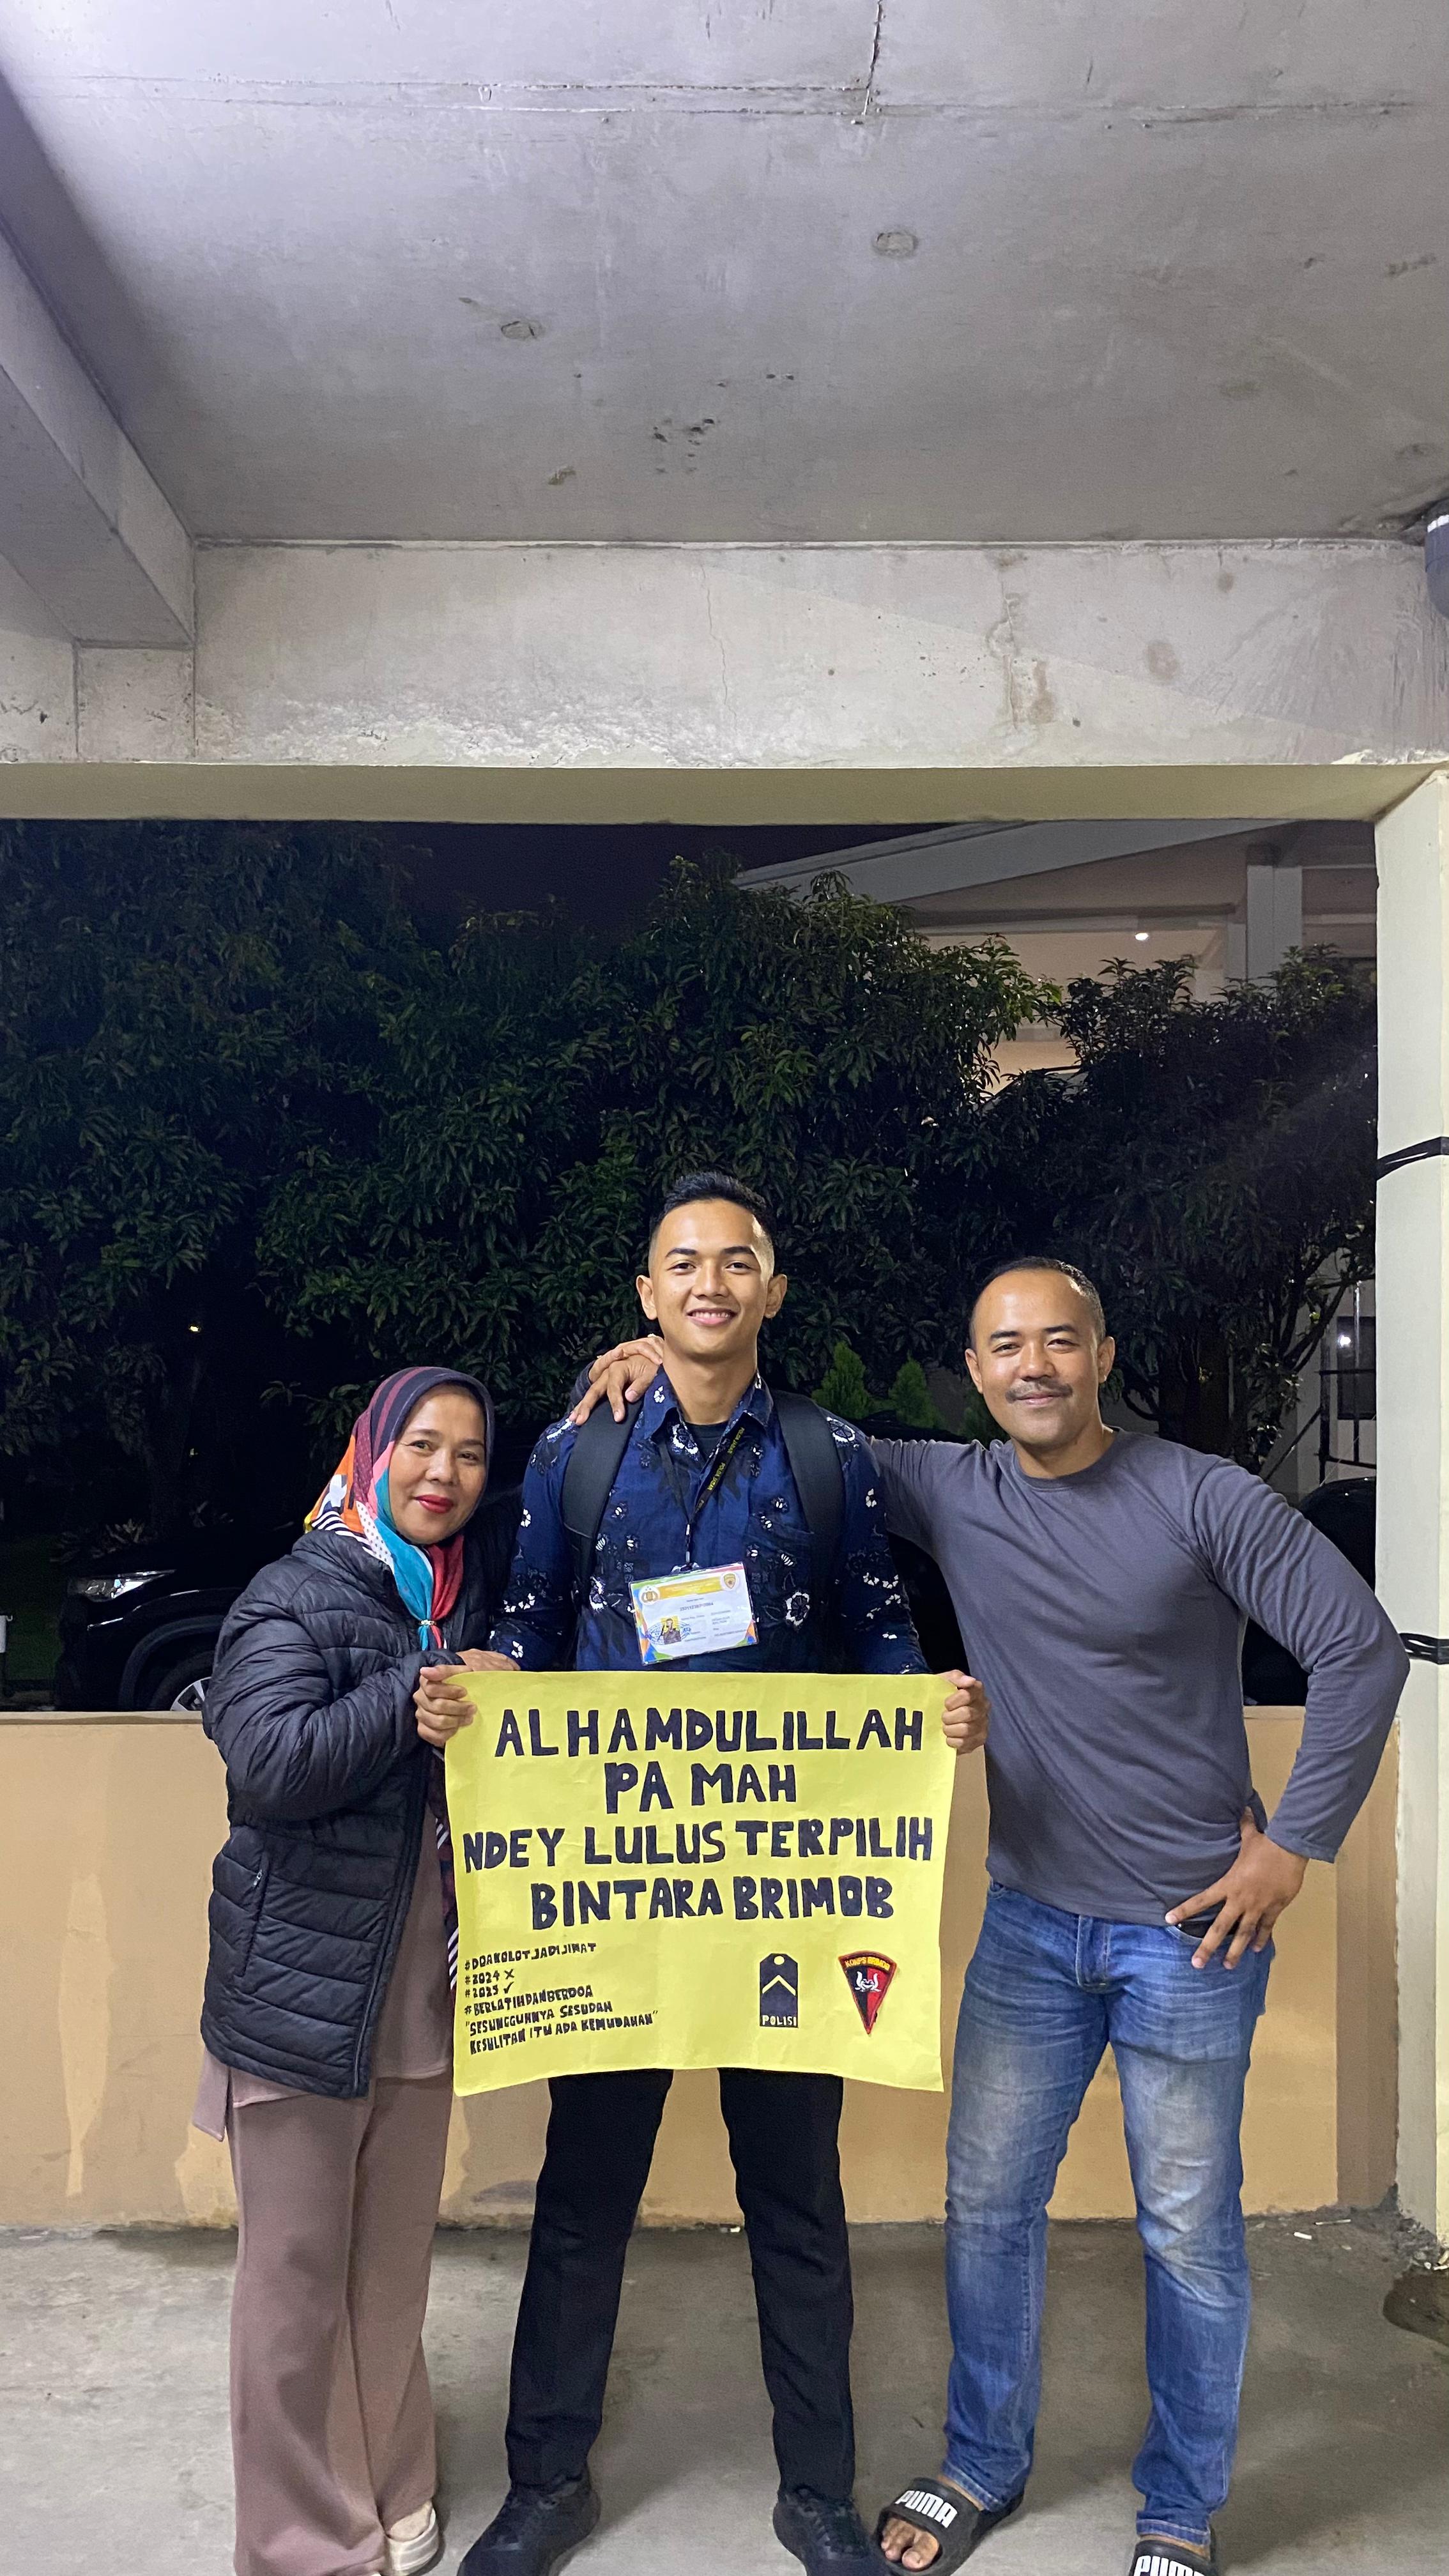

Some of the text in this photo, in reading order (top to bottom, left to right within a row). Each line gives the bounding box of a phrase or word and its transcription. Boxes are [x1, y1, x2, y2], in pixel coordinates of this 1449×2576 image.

[494, 1707, 923, 1757] ALHAMDULILLAH
[604, 1761, 796, 1814] PA MAH
[463, 1816, 932, 1874] NDEY LULUS TERPILIH
[531, 1876, 894, 1930] BINTARA BRIMOB
[844, 1957, 866, 1968] KORPS
[470, 2028, 526, 2055] KESULITAN
[530, 2023, 553, 2038] ITU
[555, 2021, 578, 2035] ADA
[762, 2014, 797, 2027] POLISI
[895, 2490, 957, 2528] PUMA
